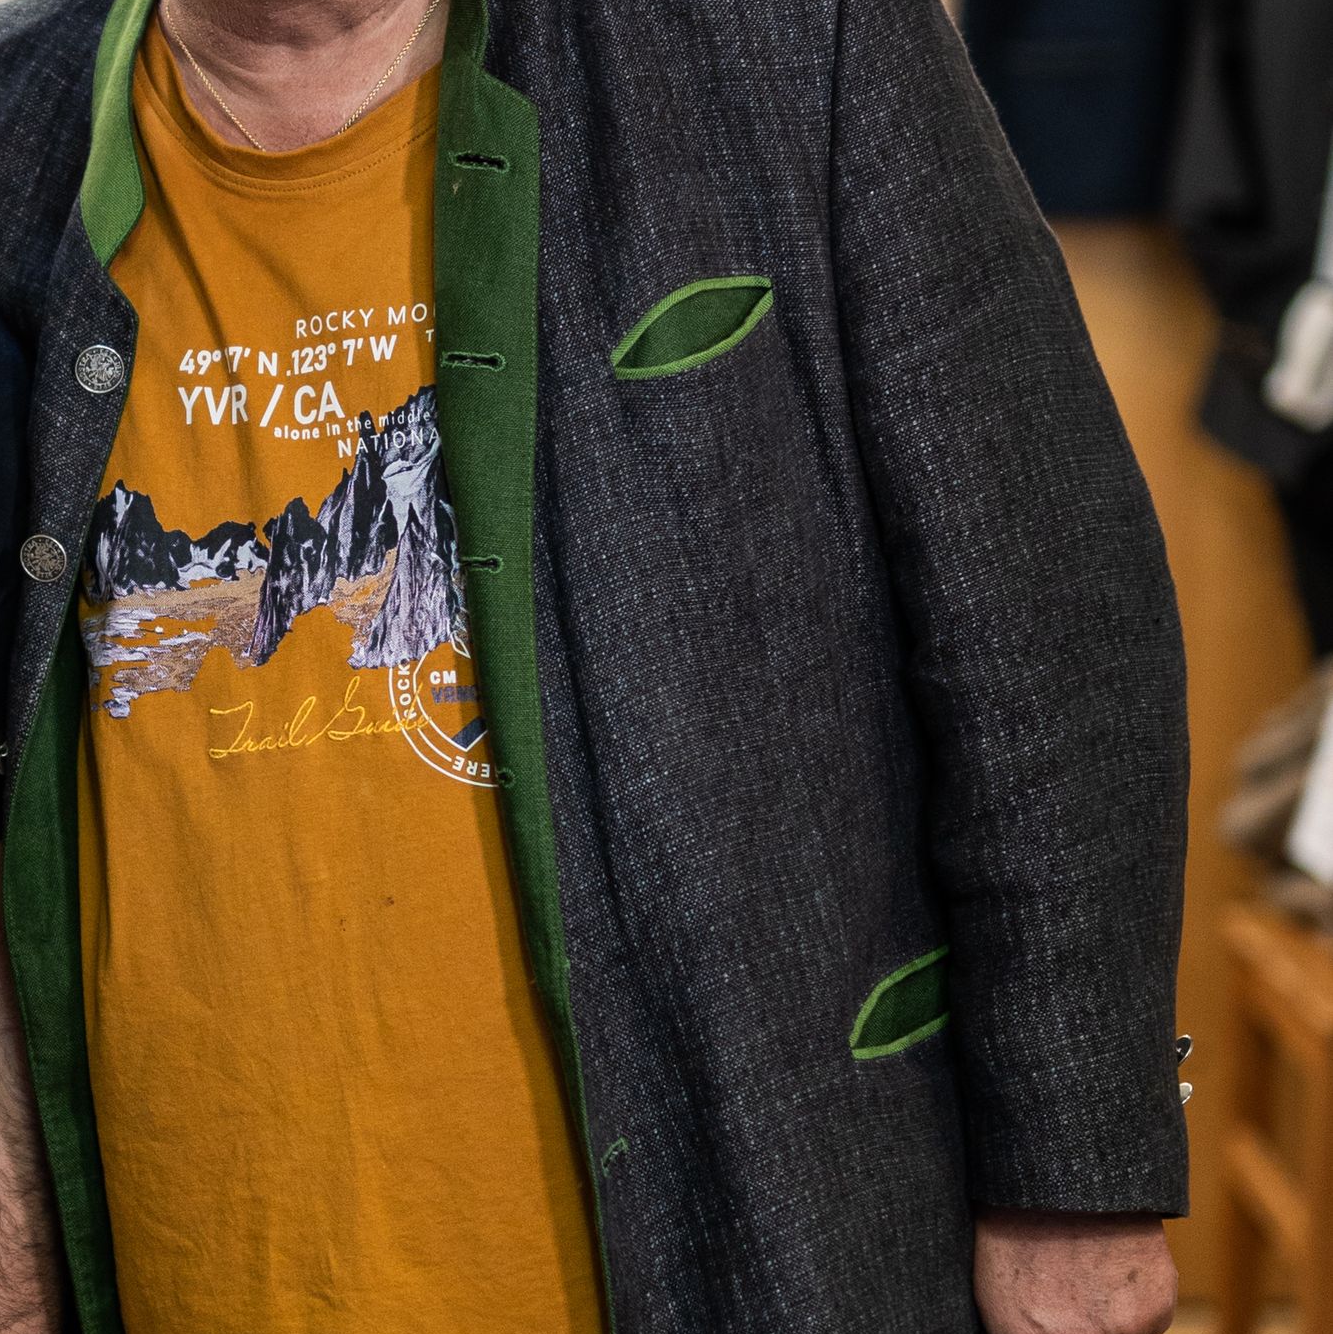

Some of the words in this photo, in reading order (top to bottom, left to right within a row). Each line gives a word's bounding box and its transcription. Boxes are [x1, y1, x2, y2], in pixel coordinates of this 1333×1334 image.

[296, 308, 374, 339] ROCKY
[388, 303, 436, 326] MO
[258, 351, 278, 377] N
[369, 335, 398, 362] W
[177, 383, 249, 426] YVR
[294, 380, 346, 426] CA
[273, 424, 320, 441] alone
[326, 422, 341, 437] in
[346, 416, 372, 434] the
[378, 409, 431, 429] middle
[209, 696, 317, 759] Trail
